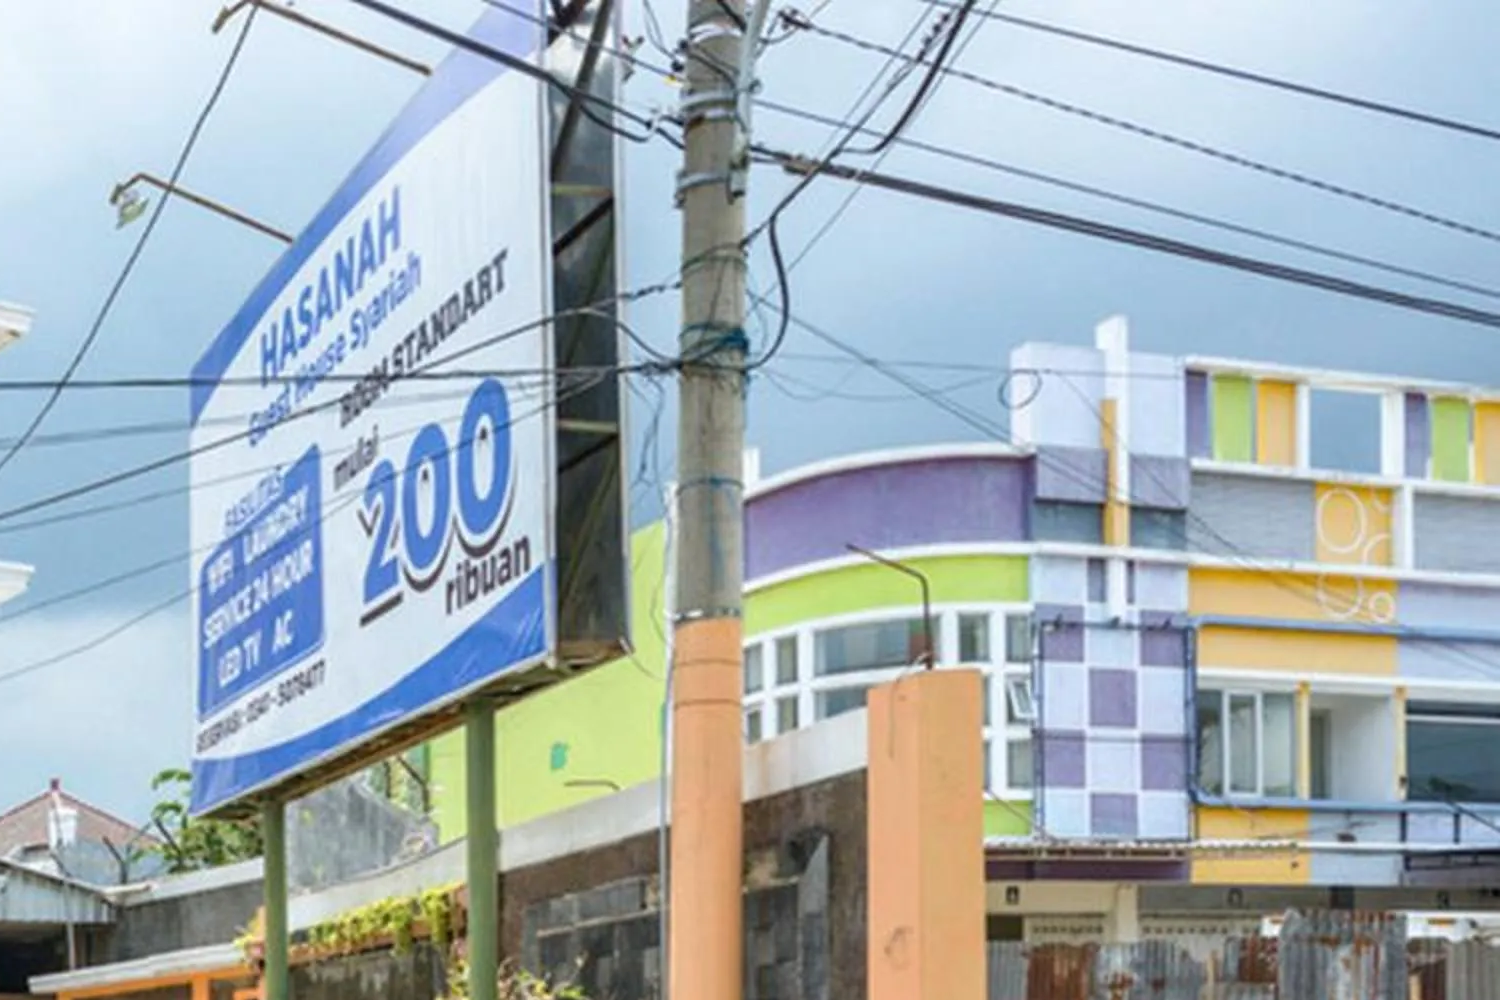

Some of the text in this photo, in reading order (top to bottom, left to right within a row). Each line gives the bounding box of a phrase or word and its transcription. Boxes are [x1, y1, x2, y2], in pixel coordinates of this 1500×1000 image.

[259, 185, 403, 388] HASANAH
[350, 252, 422, 350] Syariah
[392, 247, 508, 375] STANDART
[334, 424, 379, 490] mulai
[363, 377, 511, 606] 200
[270, 538, 313, 600] HOUR
[445, 536, 531, 615] ribuan
[271, 609, 293, 655] AC
